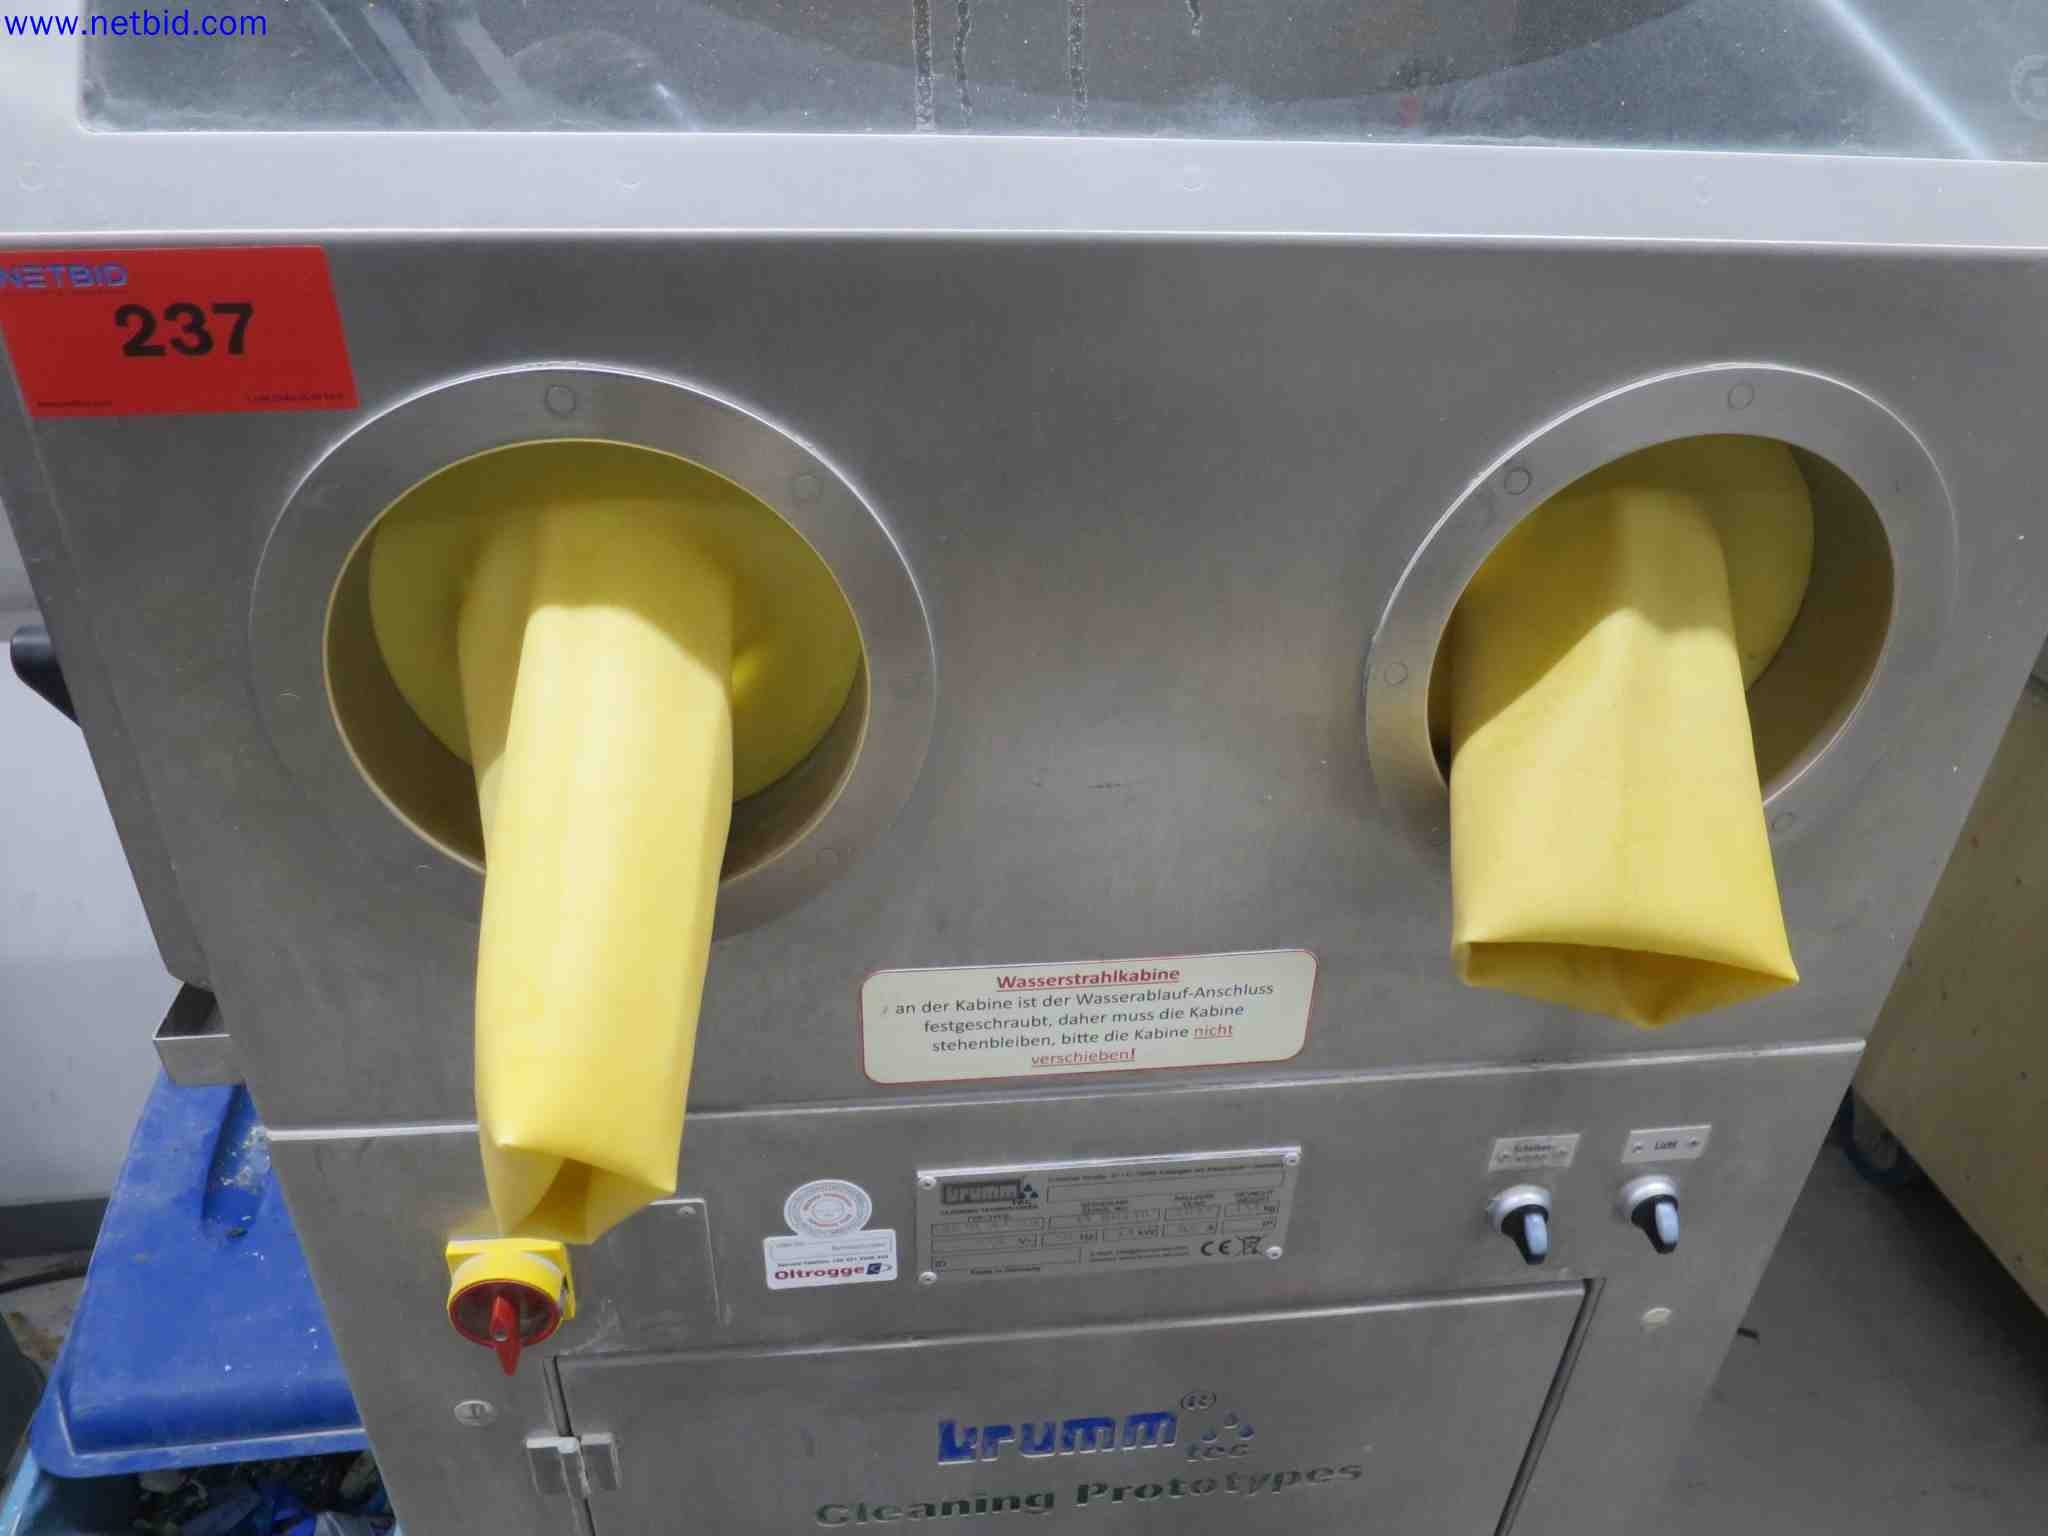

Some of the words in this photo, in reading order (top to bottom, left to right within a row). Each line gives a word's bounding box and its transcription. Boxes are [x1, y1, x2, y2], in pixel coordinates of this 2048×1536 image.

[0, 263, 128, 289] NETBID
[115, 302, 255, 358] 237
[996, 967, 1180, 991] Wasserstrahlkabine
[895, 1003, 916, 1014] an
[922, 998, 950, 1013] der
[955, 995, 1013, 1012] Kabine
[1018, 995, 1037, 1009] ist
[1042, 993, 1070, 1008] der
[1076, 982, 1274, 1006] Wasserablauf-Anschluss
[924, 1014, 1052, 1034] festgeschraubt,
[1058, 1010, 1106, 1026] daher
[1112, 1010, 1154, 1023] muss
[1159, 1007, 1184, 1020] die
[1189, 1003, 1244, 1019] Kabine
[932, 1034, 1056, 1052] stehenbleiben,
[1061, 1030, 1098, 1045] bitte
[1104, 1028, 1129, 1043] die
[1134, 1025, 1189, 1040] Kabine
[1193, 1023, 1233, 1040] nicht
[1031, 1048, 1136, 1067] verschieben!
[775, 1266, 864, 1279] Oltrogge
[937, 1409, 1177, 1464] krumm
[816, 1490, 1054, 1527] Cleaning
[1075, 1461, 1363, 1507] Prototypes
